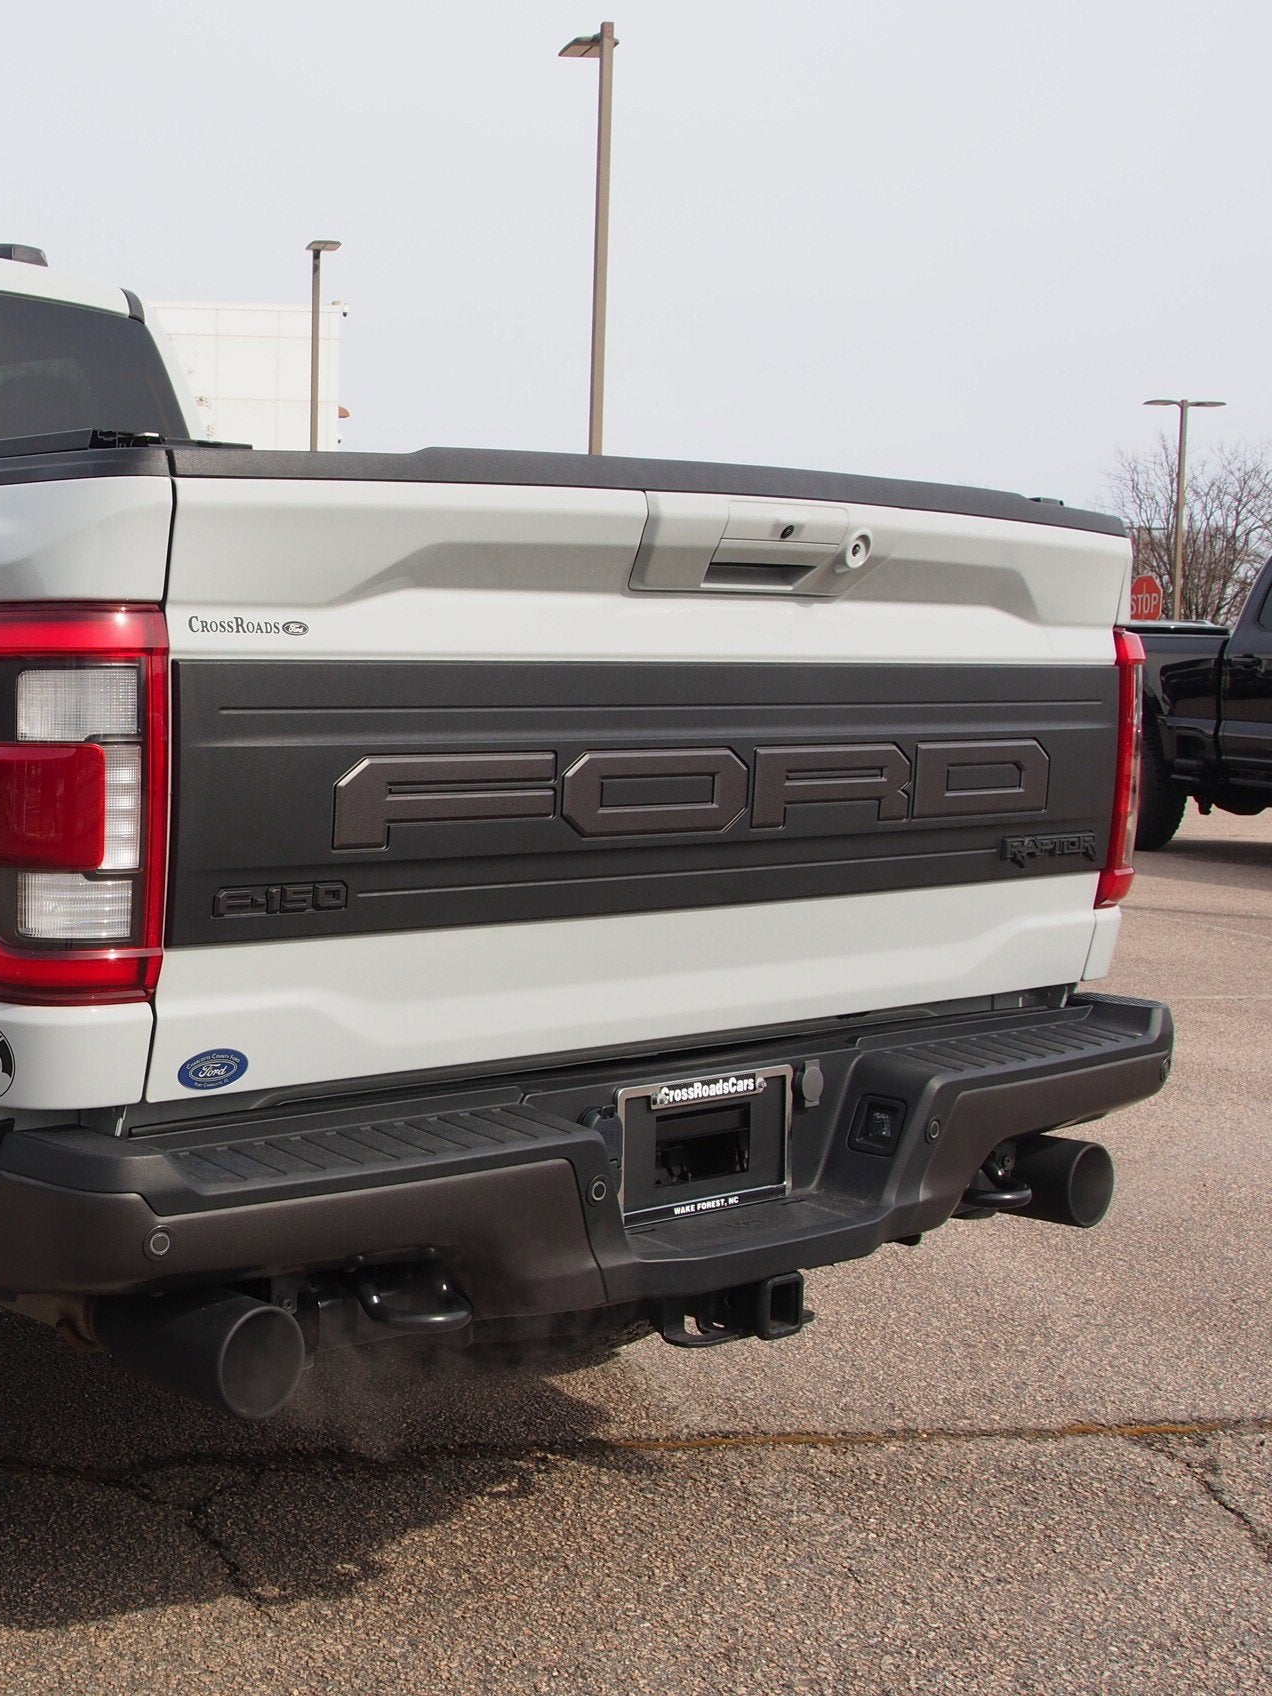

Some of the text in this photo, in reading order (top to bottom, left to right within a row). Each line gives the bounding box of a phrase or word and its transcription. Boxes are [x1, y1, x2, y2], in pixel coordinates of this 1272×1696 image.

[1131, 593, 1159, 615] STOP
[332, 737, 1050, 852] FORD
[1000, 830, 1096, 869] RAPTOR
[212, 880, 348, 918] F-150
[198, 1063, 228, 1078] Ford
[661, 1077, 755, 1104] CrossRoadsCars
[673, 1196, 740, 1216] WAKE FOREST, NC
